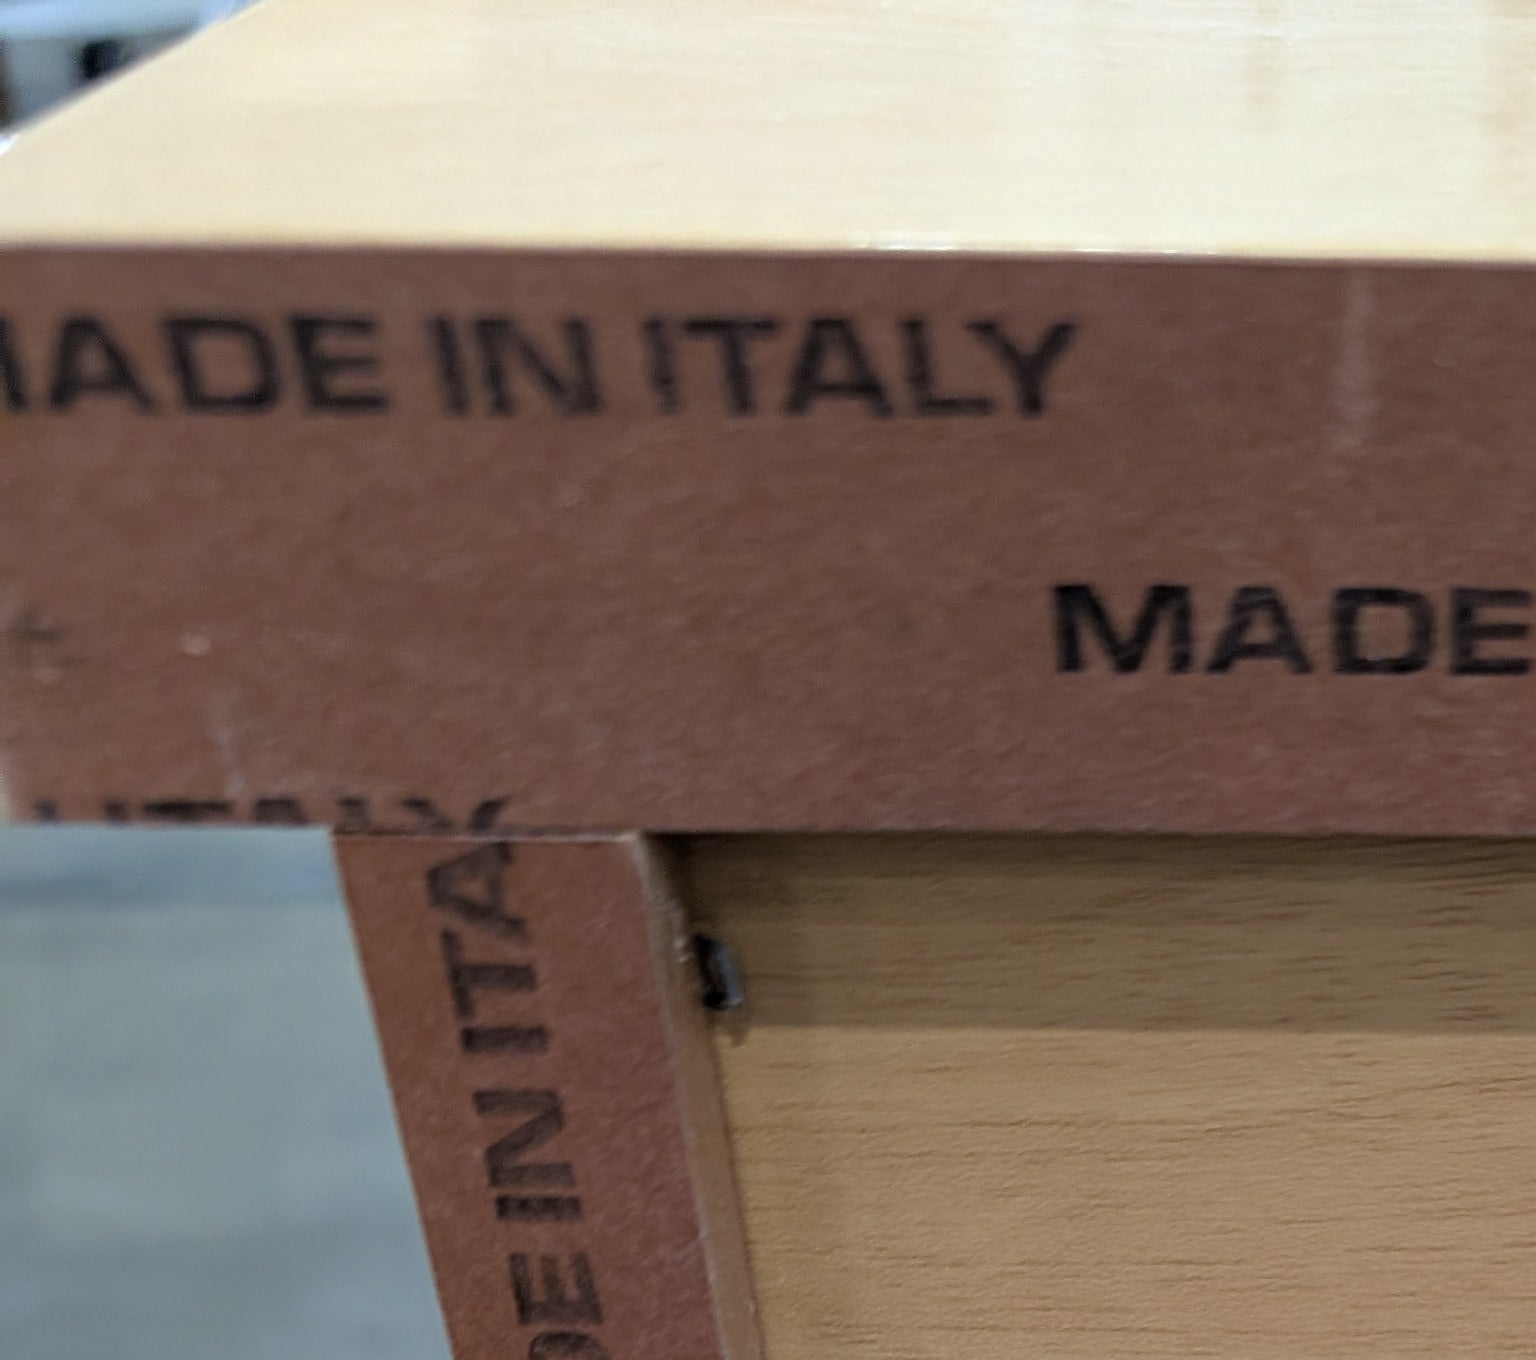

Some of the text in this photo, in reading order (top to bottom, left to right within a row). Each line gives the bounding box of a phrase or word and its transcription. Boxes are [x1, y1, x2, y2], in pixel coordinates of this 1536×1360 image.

[0, 312, 1079, 419] ADE IN ITALY
[1050, 582, 1534, 677] MADE
[472, 1087, 583, 1223] IN
